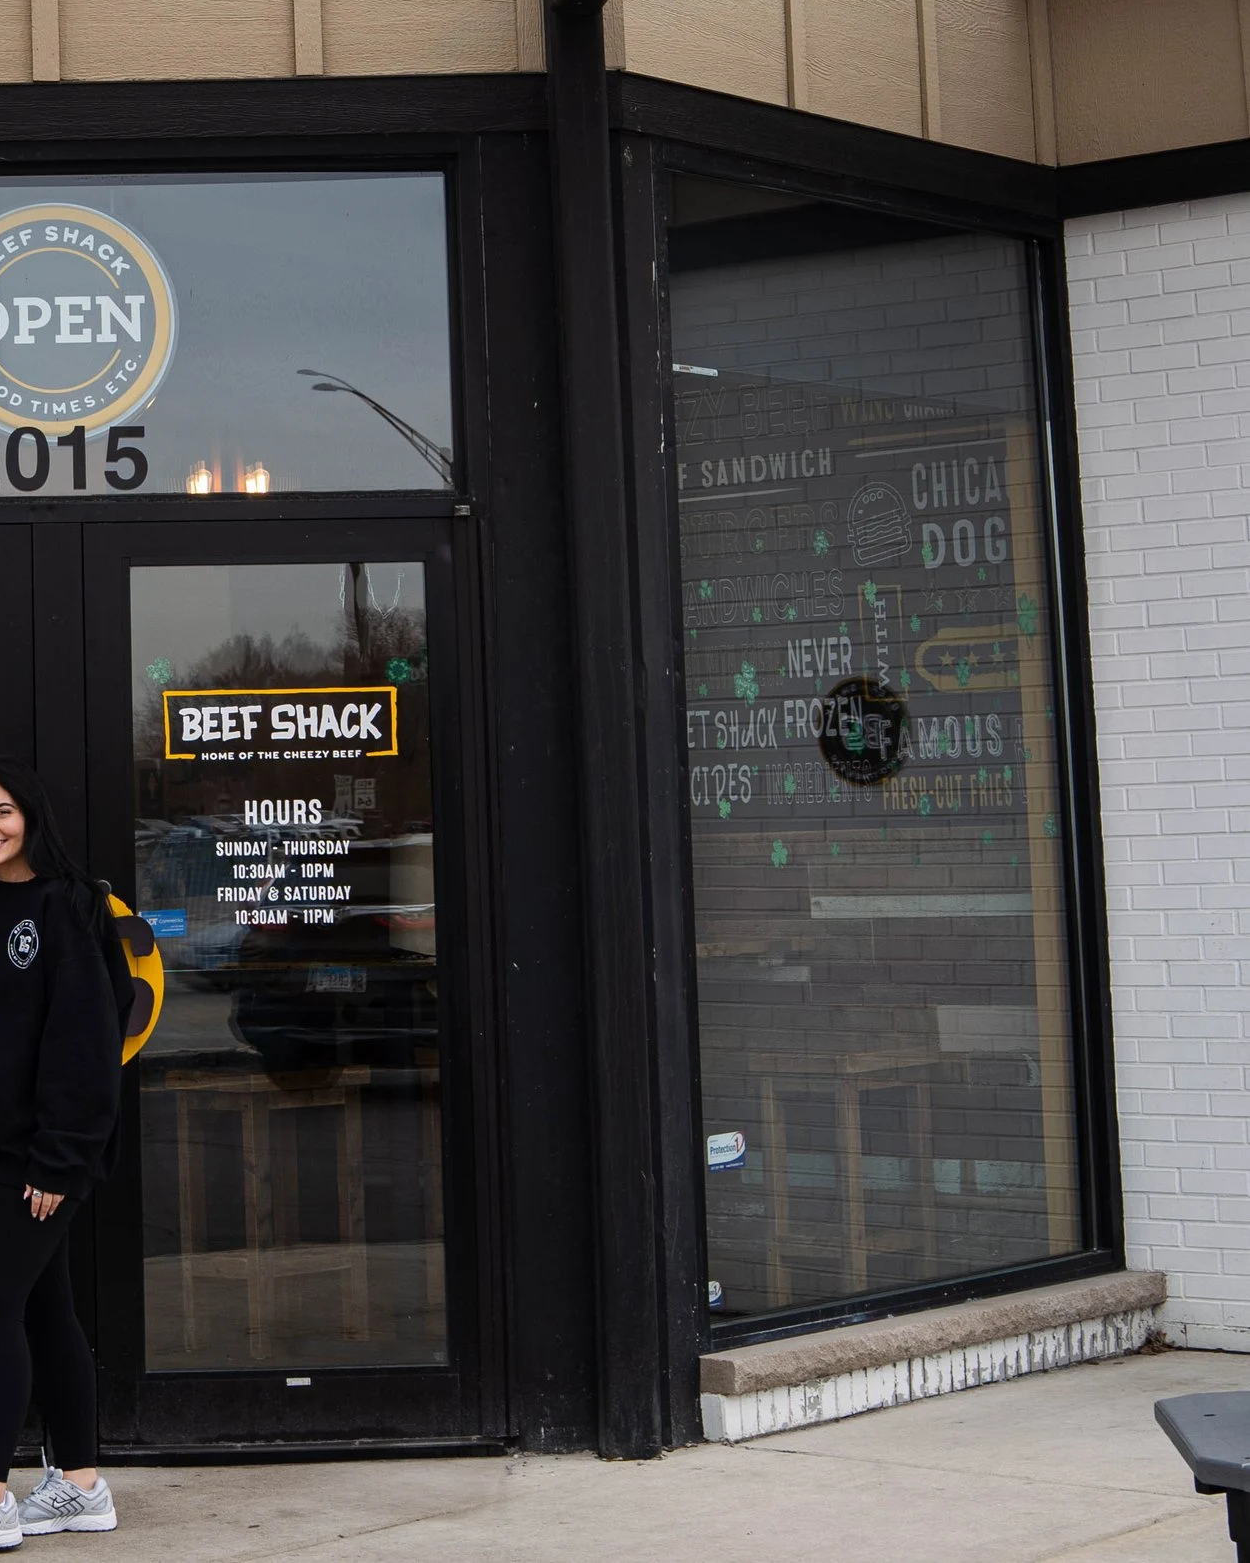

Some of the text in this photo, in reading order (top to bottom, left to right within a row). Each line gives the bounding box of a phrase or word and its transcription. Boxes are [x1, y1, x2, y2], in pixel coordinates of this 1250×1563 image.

[45, 225, 131, 275] SHACK
[31, 395, 105, 415] TIMES,
[104, 353, 142, 394] ETC.
[702, 446, 832, 488] SANDWICH
[911, 455, 1010, 511] CHICA
[922, 516, 1008, 569] DOG
[680, 568, 846, 626] ANDWICHES
[787, 636, 852, 678] NEVER
[873, 597, 891, 690] WITH
[179, 703, 382, 742] BEEF SHACK
[783, 695, 863, 738] FROZEN
[879, 713, 1003, 761] FAMOUS
[201, 749, 363, 761] HOME OF THE CHEEZY BEEF
[690, 763, 751, 806] CIPES
[883, 771, 1013, 811] FRESH-CUT FRIES
[244, 798, 323, 825] HOURS
[215, 841, 267, 857] SUNDAY
[282, 840, 350, 856] THURSDAY
[232, 863, 285, 879] 10:30AM
[300, 863, 334, 878] 10PM
[217, 885, 351, 902] FRIDAY & SATURDAY
[234, 910, 288, 925] 10:30AM
[303, 909, 334, 924] 11PM
